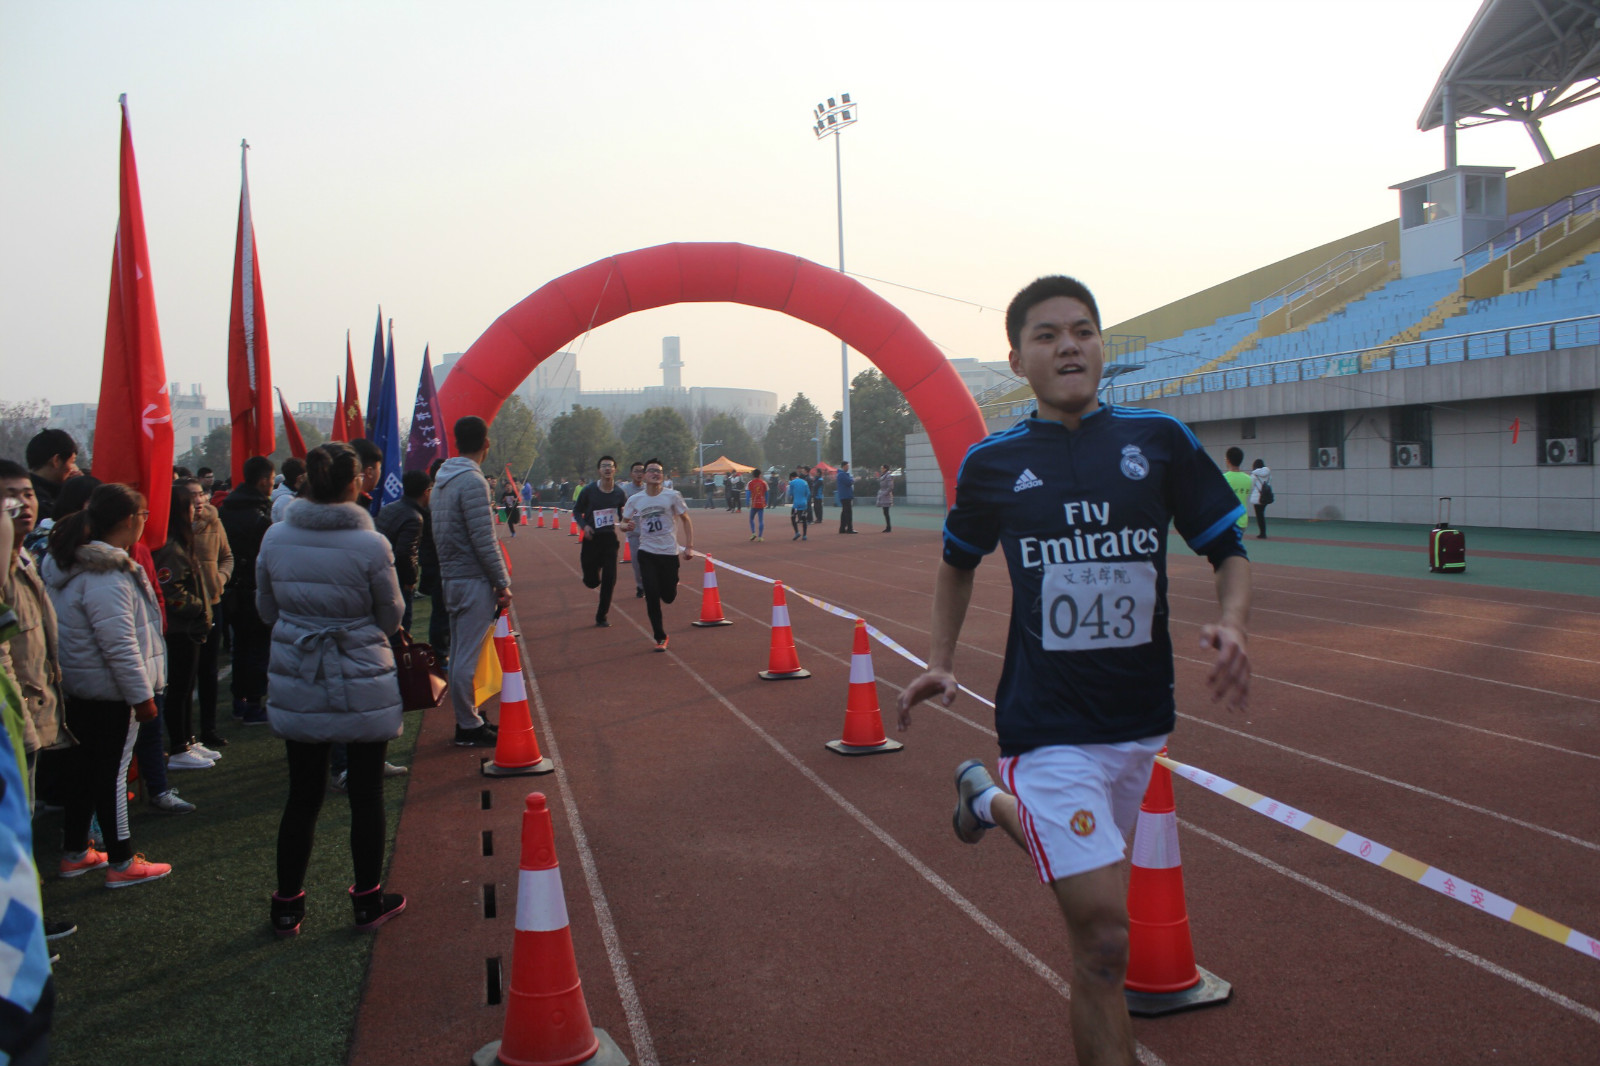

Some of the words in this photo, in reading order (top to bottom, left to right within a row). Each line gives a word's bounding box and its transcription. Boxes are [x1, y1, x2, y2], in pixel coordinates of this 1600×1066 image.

[1013, 479, 1044, 493] adidas
[1063, 500, 1110, 526] Fly
[647, 520, 662, 532] 20
[1019, 526, 1159, 568] Emirates
[1063, 566, 1132, 585] 文法学院
[1050, 593, 1136, 640] 043
